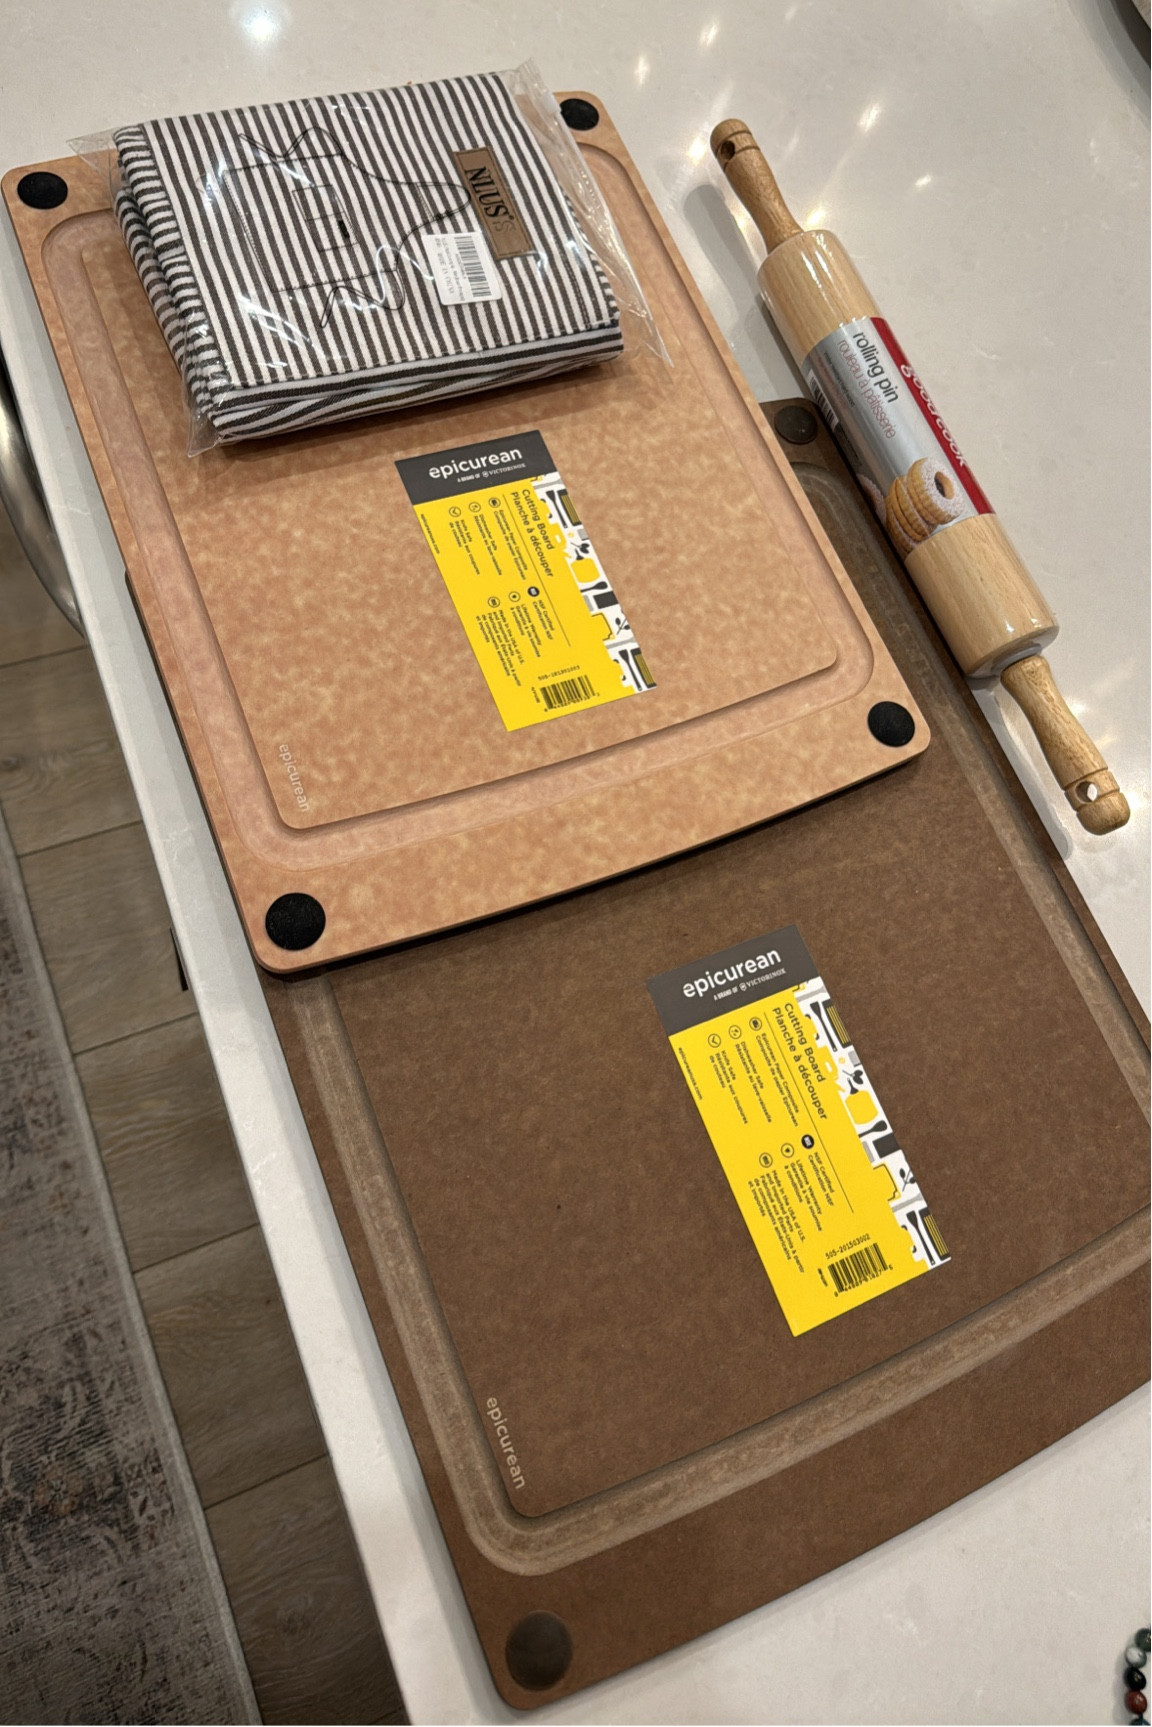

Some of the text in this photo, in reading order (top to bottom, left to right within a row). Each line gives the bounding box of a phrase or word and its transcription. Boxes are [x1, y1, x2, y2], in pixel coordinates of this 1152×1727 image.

[837, 340, 863, 380] rouleau
[853, 332, 899, 403] rolling pin
[858, 380, 869, 388] à
[862, 387, 896, 439] pâtisserie
[429, 449, 522, 479] epicurean
[510, 491, 530, 526] Planche
[529, 535, 554, 577] découper
[521, 488, 555, 550] Cutting Board
[279, 744, 310, 812] epicurean
[683, 950, 781, 997] epicurean
[745, 967, 786, 987] VICTORINOX
[720, 1049, 736, 1081] Knife Safe
[740, 1040, 764, 1089] Dishwasher Safe
[772, 1006, 827, 1119] Planche à découper
[784, 1002, 826, 1082] Cutting Board
[708, 1054, 726, 1089] de couteau
[755, 1034, 799, 1127] Composite de papier Epicurean
[761, 1032, 799, 1113] Epicurean Paper Composite
[786, 1169, 803, 1203] conditions
[789, 1162, 804, 1189] Garantie
[795, 1159, 822, 1215] Lifetime Warranty
[807, 1154, 834, 1206] Certification NSF
[813, 1151, 835, 1193] NSF Certified
[753, 1177, 760, 1187] de
[757, 1187, 777, 1226] composants
[765, 1172, 775, 1185] and
[784, 1214, 794, 1233] Parts
[771, 1169, 782, 1188] Made
[782, 1194, 790, 1206] the
[787, 1206, 797, 1221] USA
[793, 1221, 801, 1229] of
[797, 1229, 806, 1243] U.S.
[771, 1203, 780, 1216] aux
[824, 1233, 870, 1260] 505-201503002
[487, 1397, 525, 1489] epicurean
